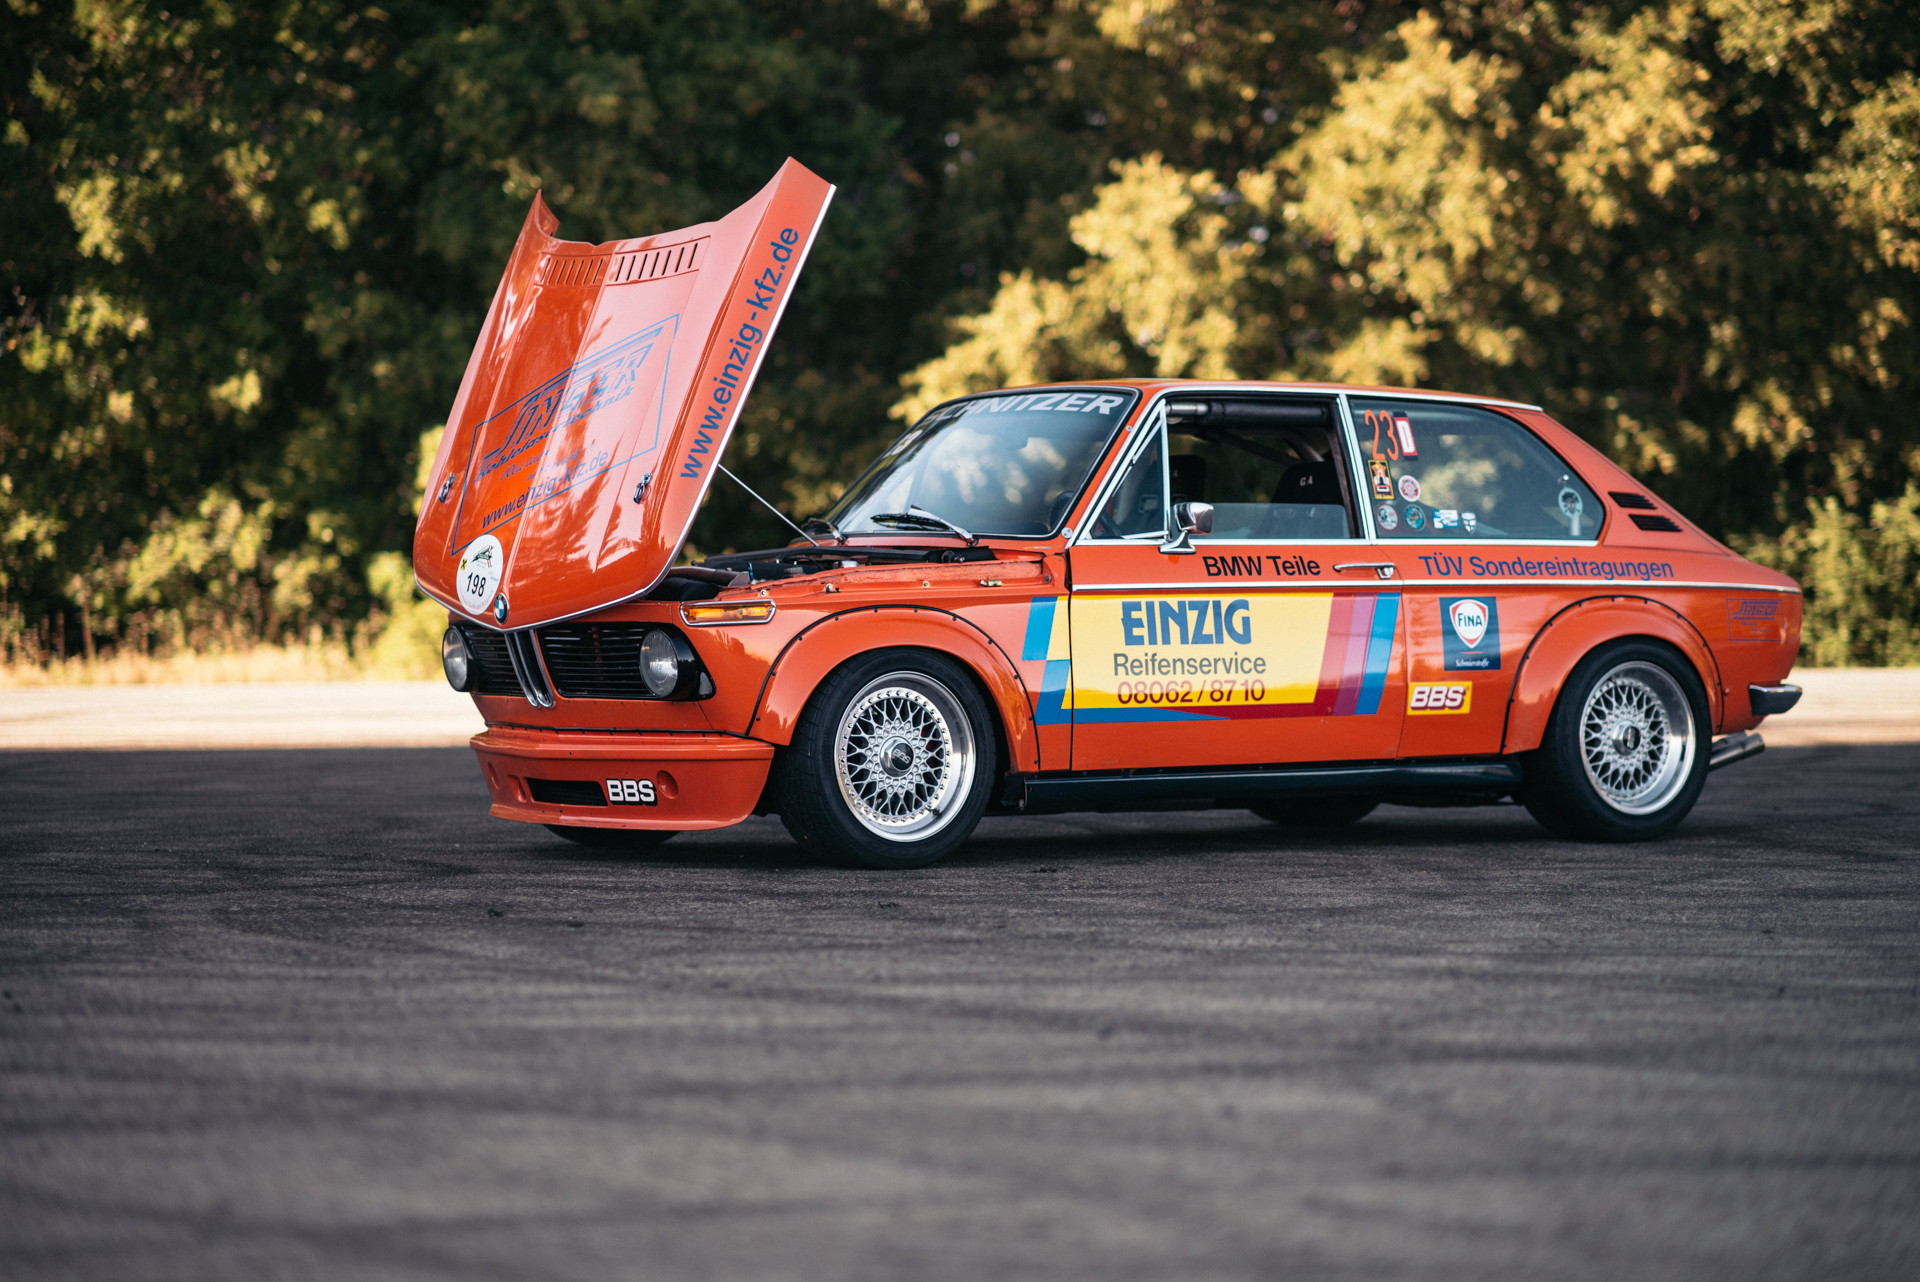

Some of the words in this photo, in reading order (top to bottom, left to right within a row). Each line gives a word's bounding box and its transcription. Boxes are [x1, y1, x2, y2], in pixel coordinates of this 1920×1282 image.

[681, 228, 799, 479] www.einzig-kfz.de
[917, 393, 1124, 428] SCHNITZER
[1364, 410, 1399, 461] 23
[1202, 555, 1261, 578] BMW
[1267, 554, 1321, 576] Teile
[1418, 553, 1467, 577] TÜV
[1470, 556, 1674, 581] Sondereintragungen
[467, 572, 486, 597] 198
[1120, 598, 1251, 646] EINZIG
[1458, 613, 1482, 627] FINA
[1113, 651, 1267, 676] Reifenservice
[1410, 686, 1466, 710] BBS
[607, 778, 655, 804] BBS
